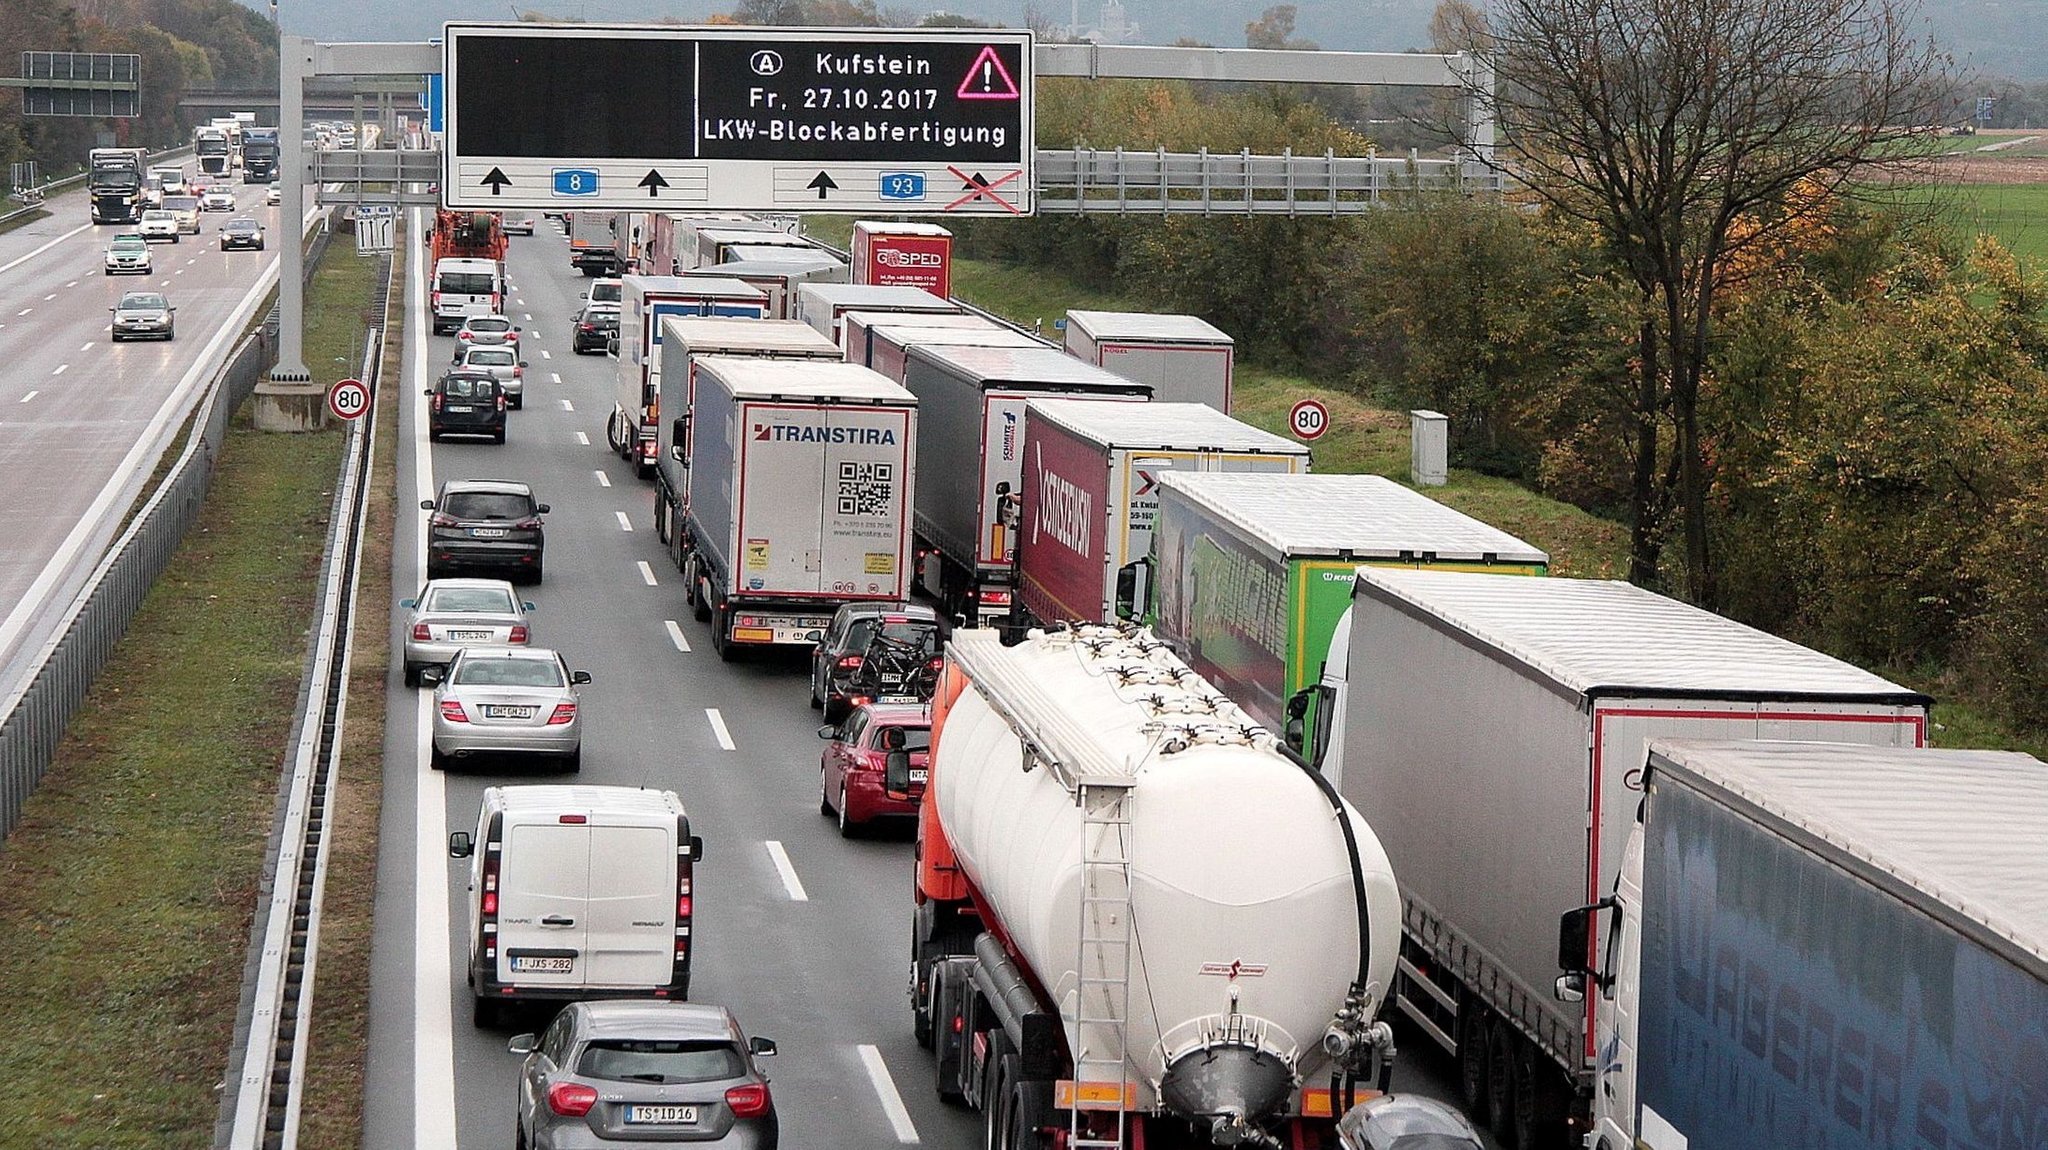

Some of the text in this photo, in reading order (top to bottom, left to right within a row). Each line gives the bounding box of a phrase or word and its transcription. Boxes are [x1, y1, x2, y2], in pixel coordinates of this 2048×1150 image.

[759, 53, 930, 75] A Kufstein
[803, 88, 938, 110] 27.10.2017
[704, 119, 1006, 148] LKW-Blockabfertigung
[570, 173, 581, 190] 8
[891, 177, 914, 194] 93
[338, 391, 361, 408] 80
[1298, 411, 1320, 428] 80
[773, 425, 896, 446] TRANSTIRA
[637, 1108, 653, 1120] TS
